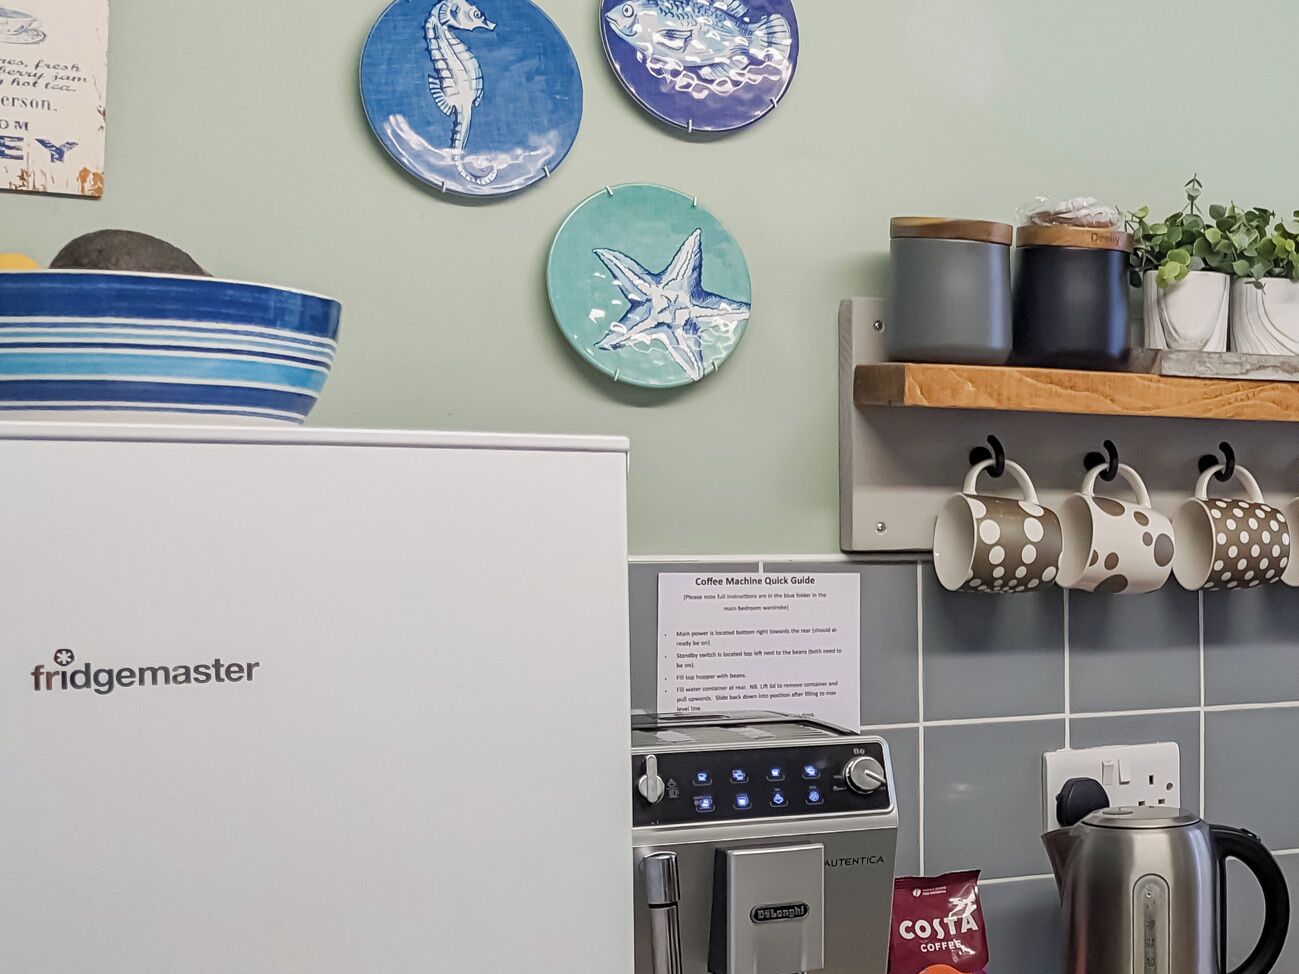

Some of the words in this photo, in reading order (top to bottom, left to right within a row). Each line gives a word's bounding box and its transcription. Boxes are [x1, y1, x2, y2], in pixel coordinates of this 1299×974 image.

[34, 59, 82, 72] fresh
[10, 77, 38, 88] hot
[54, 72, 88, 83] jam
[0, 96, 58, 112] erson.
[695, 577, 723, 586] Coffee
[725, 577, 763, 585] Machine
[764, 576, 789, 585] Quick
[790, 576, 815, 584] Guide
[31, 650, 260, 695] fridgemaster
[824, 855, 886, 868] AUTENTICA
[899, 914, 979, 940] COSTA
[920, 940, 961, 952] COFFEE
